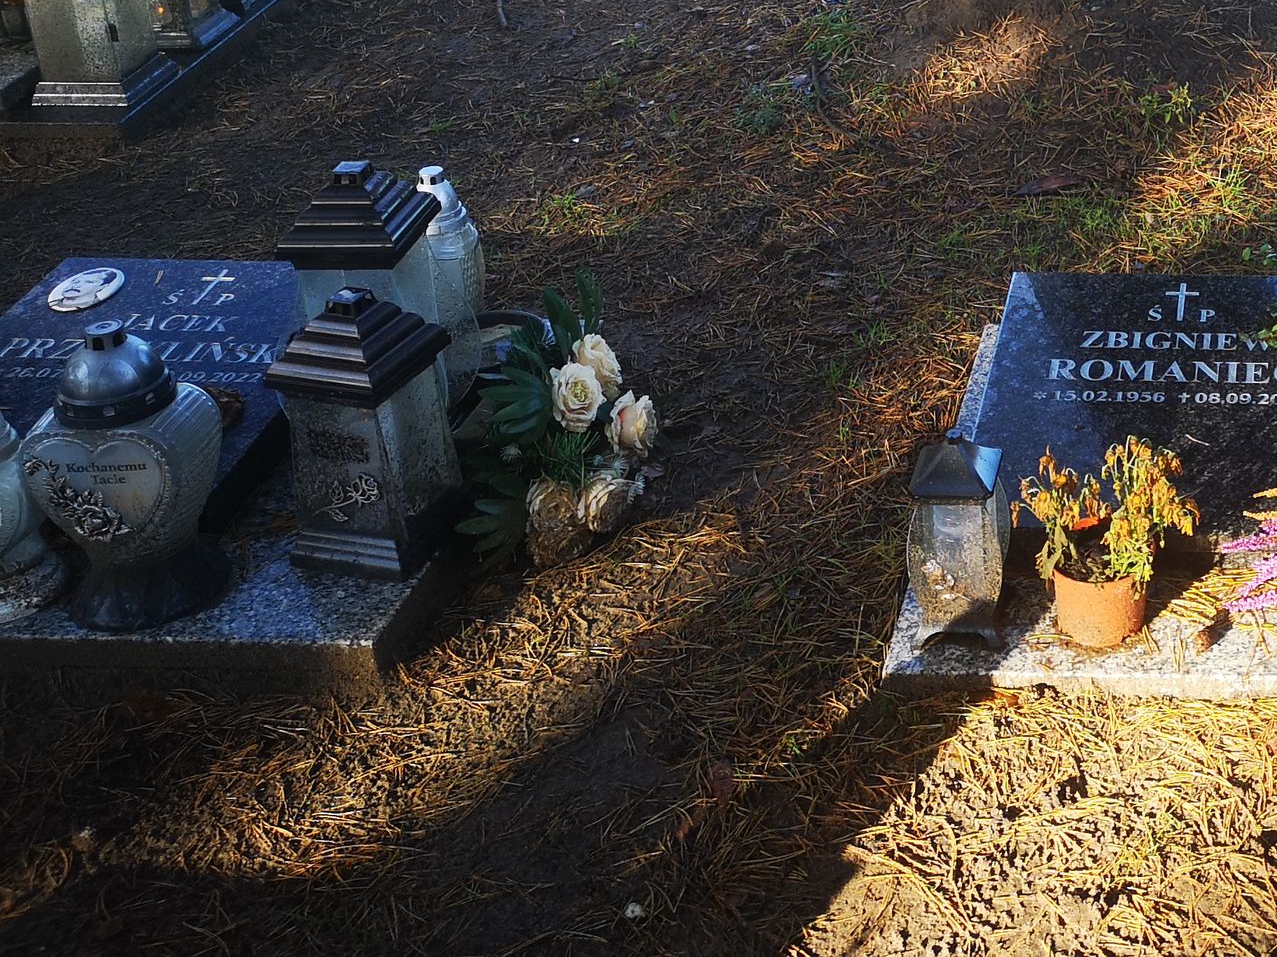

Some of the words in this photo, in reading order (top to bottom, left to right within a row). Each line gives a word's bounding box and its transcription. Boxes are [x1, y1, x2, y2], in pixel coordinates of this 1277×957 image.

[162, 288, 186, 306] Ś
[213, 293, 236, 306] P
[1147, 304, 1163, 322] Ś
[1199, 308, 1216, 323] P
[123, 313, 239, 332] JACEK
[1053, 390, 1166, 403] 15.02.1956
[65, 462, 148, 473] Kochanemu
[90, 475, 126, 485] Tacie
